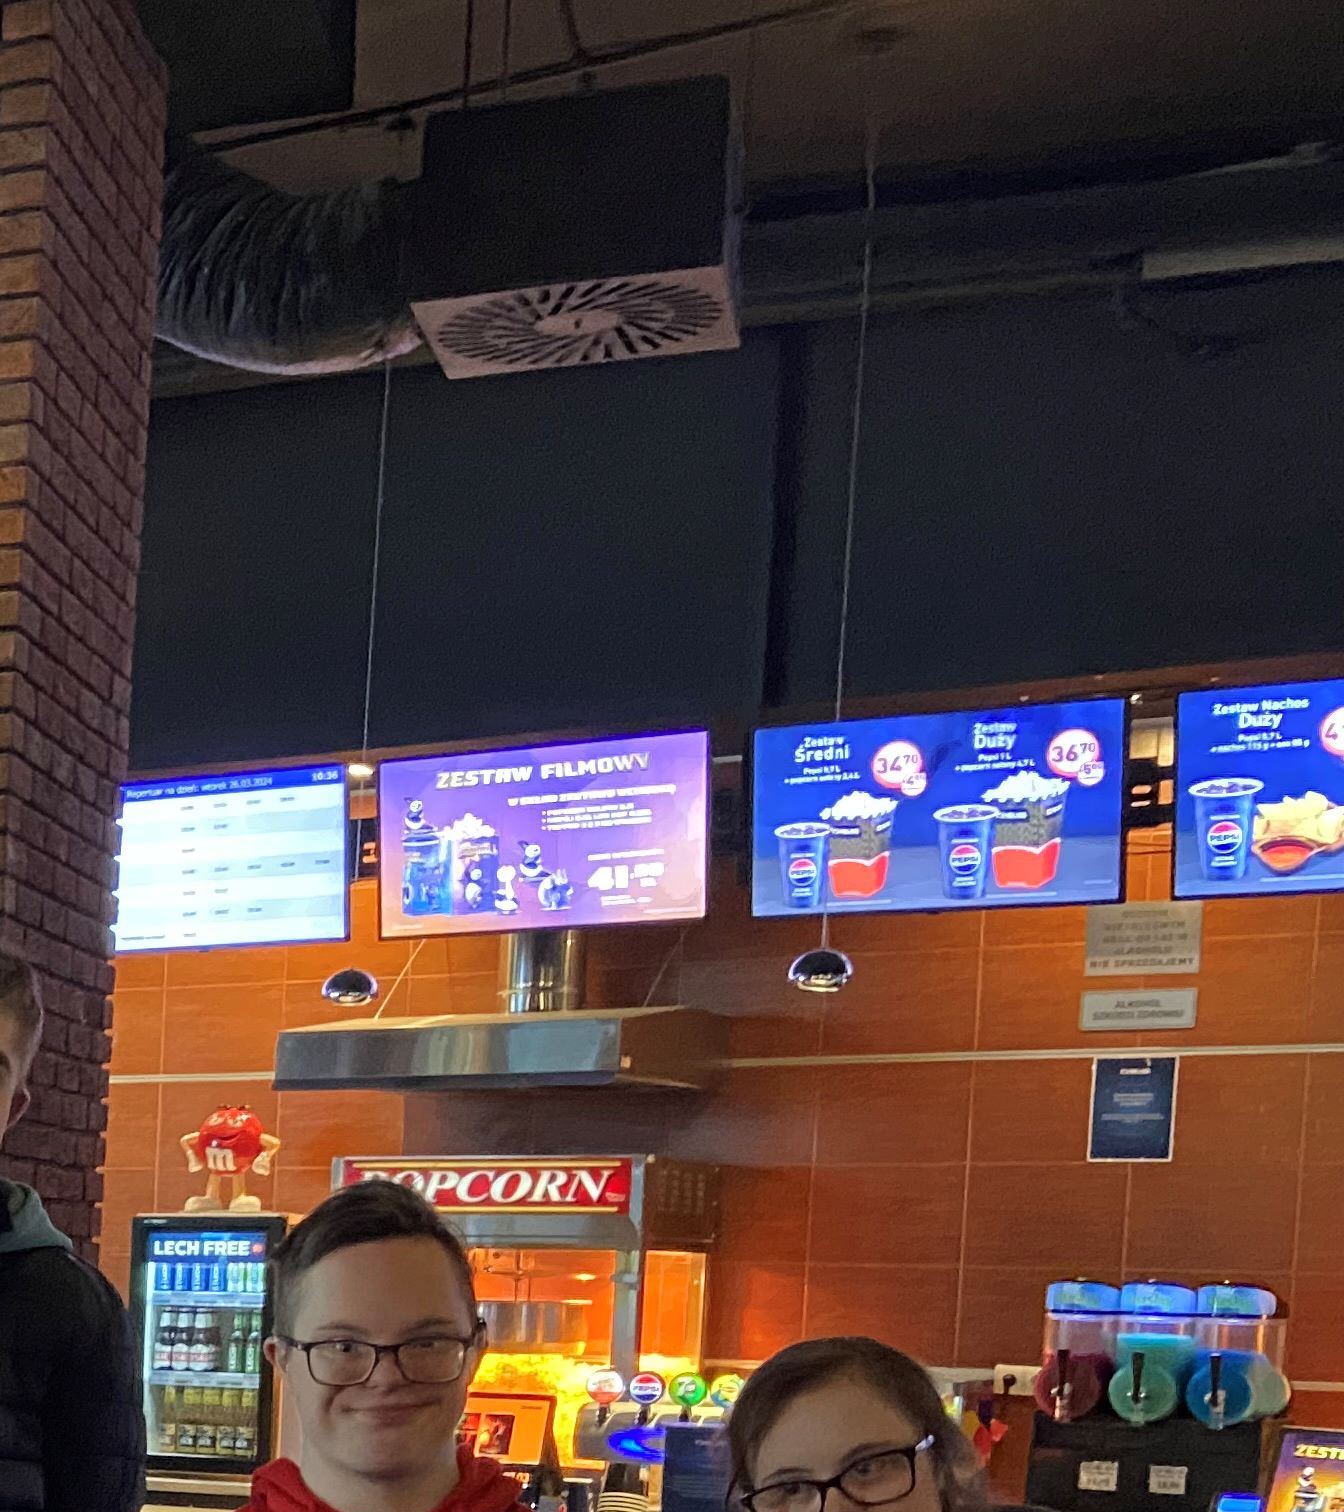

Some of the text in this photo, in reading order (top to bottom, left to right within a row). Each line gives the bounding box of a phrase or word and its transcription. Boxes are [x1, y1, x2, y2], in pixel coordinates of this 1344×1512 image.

[1261, 697, 1310, 711] Nachos
[1238, 711, 1283, 729] Duży
[973, 733, 1017, 751] Duży
[794, 743, 851, 763] Średni
[435, 751, 650, 790] ZESTAW FILMOWY
[153, 1240, 252, 1256] LECH FREE
